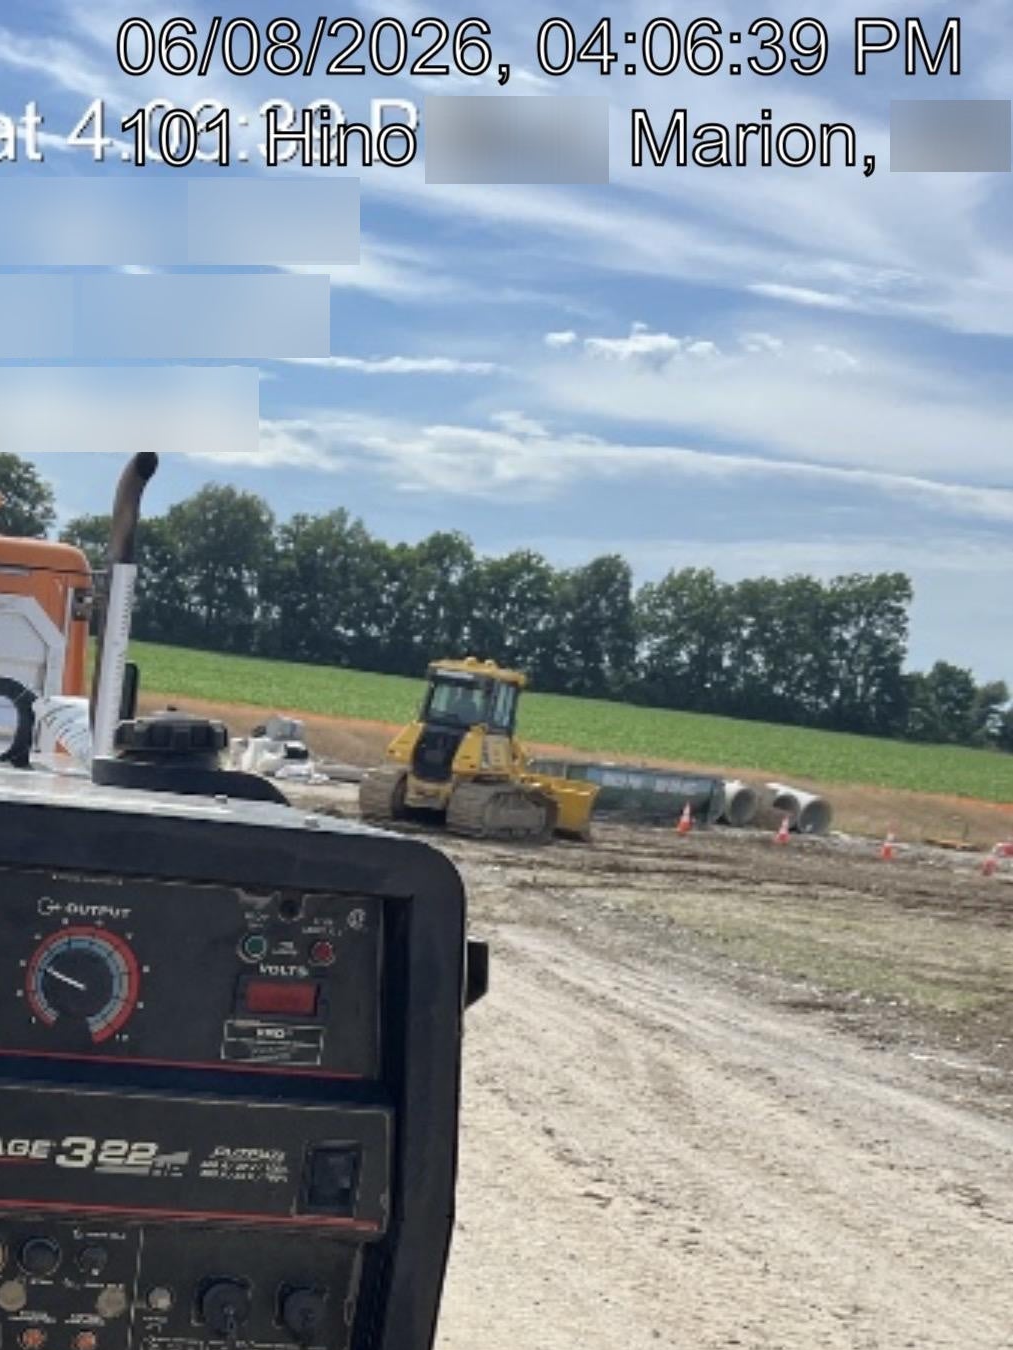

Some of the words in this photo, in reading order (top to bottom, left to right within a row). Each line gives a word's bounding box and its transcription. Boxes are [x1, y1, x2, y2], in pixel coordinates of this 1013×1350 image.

[65, 902, 132, 919] OUTPUT
[259, 964, 309, 977] VOLTS
[55, 1136, 160, 1168] 322
